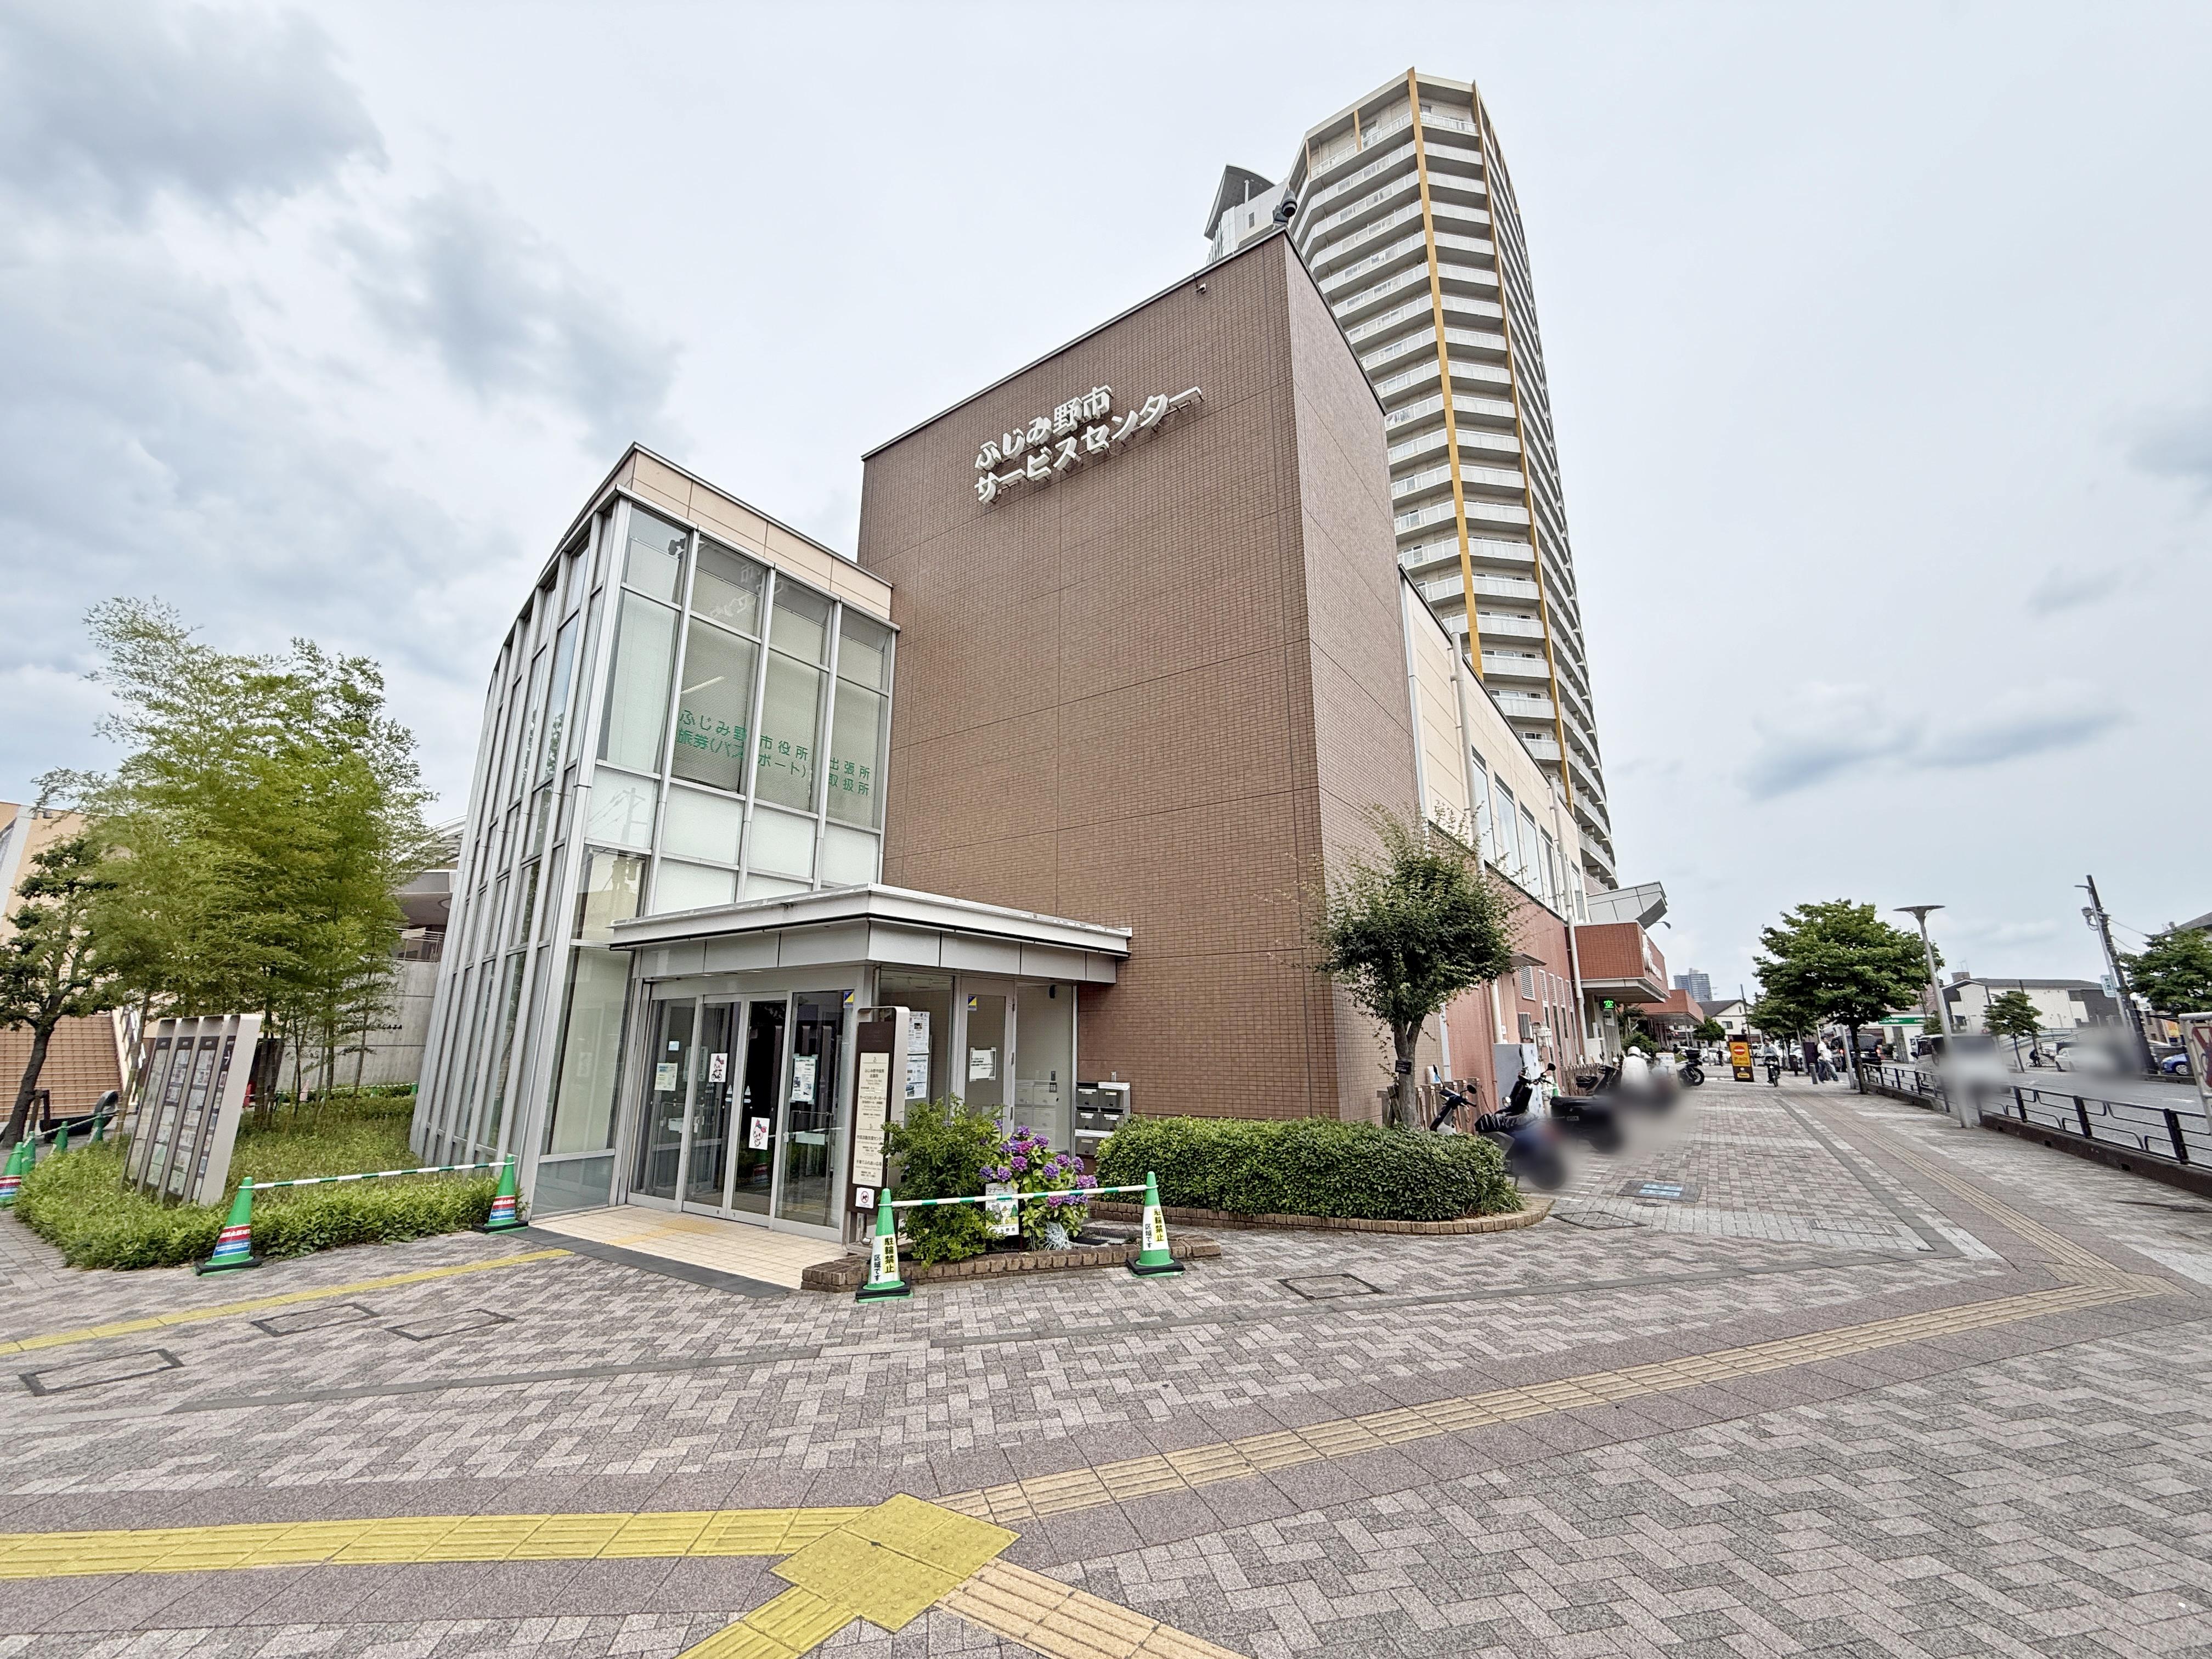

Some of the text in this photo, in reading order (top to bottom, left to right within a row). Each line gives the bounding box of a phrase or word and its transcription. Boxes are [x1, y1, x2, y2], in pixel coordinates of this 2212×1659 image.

[974, 385, 1113, 470] ふじみ野市
[974, 386, 1203, 504] サービスセンター
[884, 1237, 895, 1273] 駐輪禁止
[1154, 1208, 1164, 1242] 駐輪禁止
